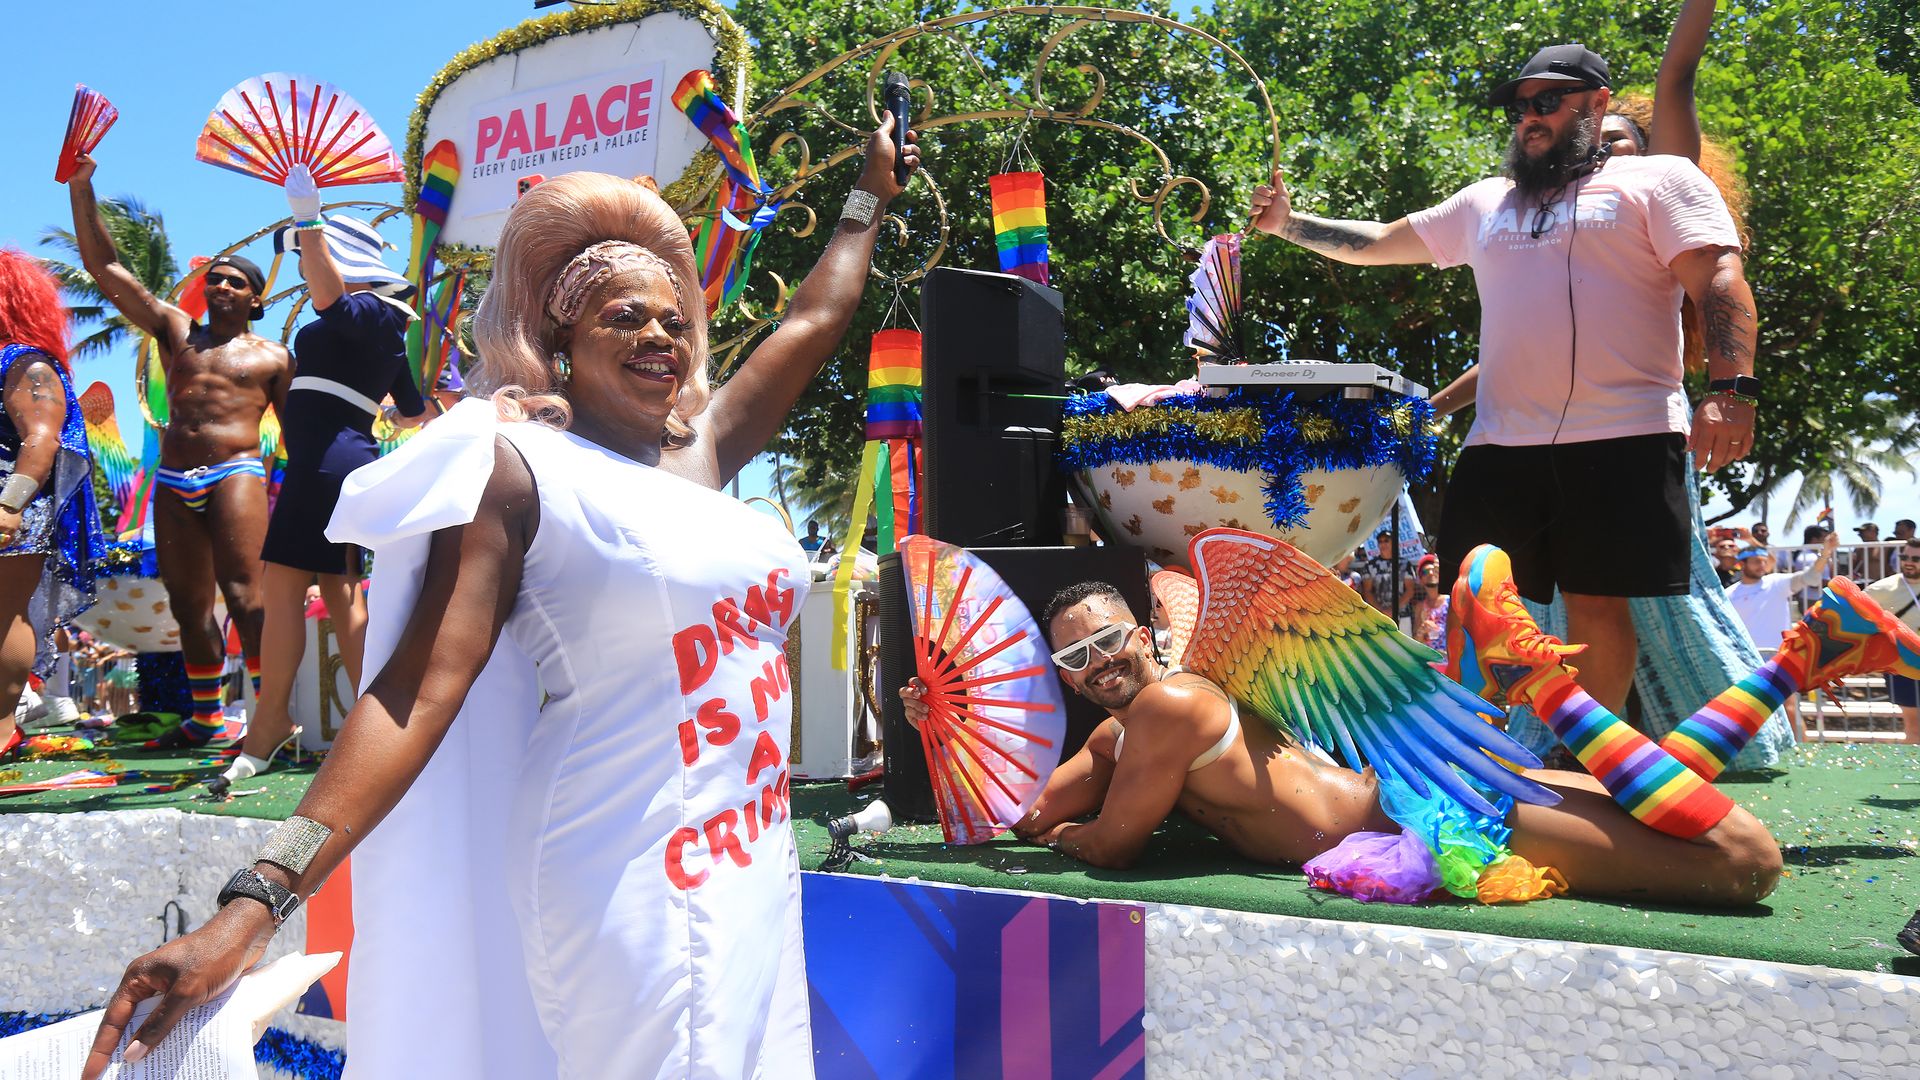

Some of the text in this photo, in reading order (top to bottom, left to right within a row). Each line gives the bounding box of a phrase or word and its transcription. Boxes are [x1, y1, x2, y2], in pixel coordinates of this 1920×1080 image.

[473, 129, 648, 179] EVERY QUEEN NEEDS A PALACE
[475, 78, 653, 165] PALACE
[1251, 369, 1299, 378] Pioneer
[672, 568, 795, 696] DRAG
[677, 640, 789, 767] IS NO
[746, 730, 782, 786] A
[665, 757, 790, 891] CRIM
